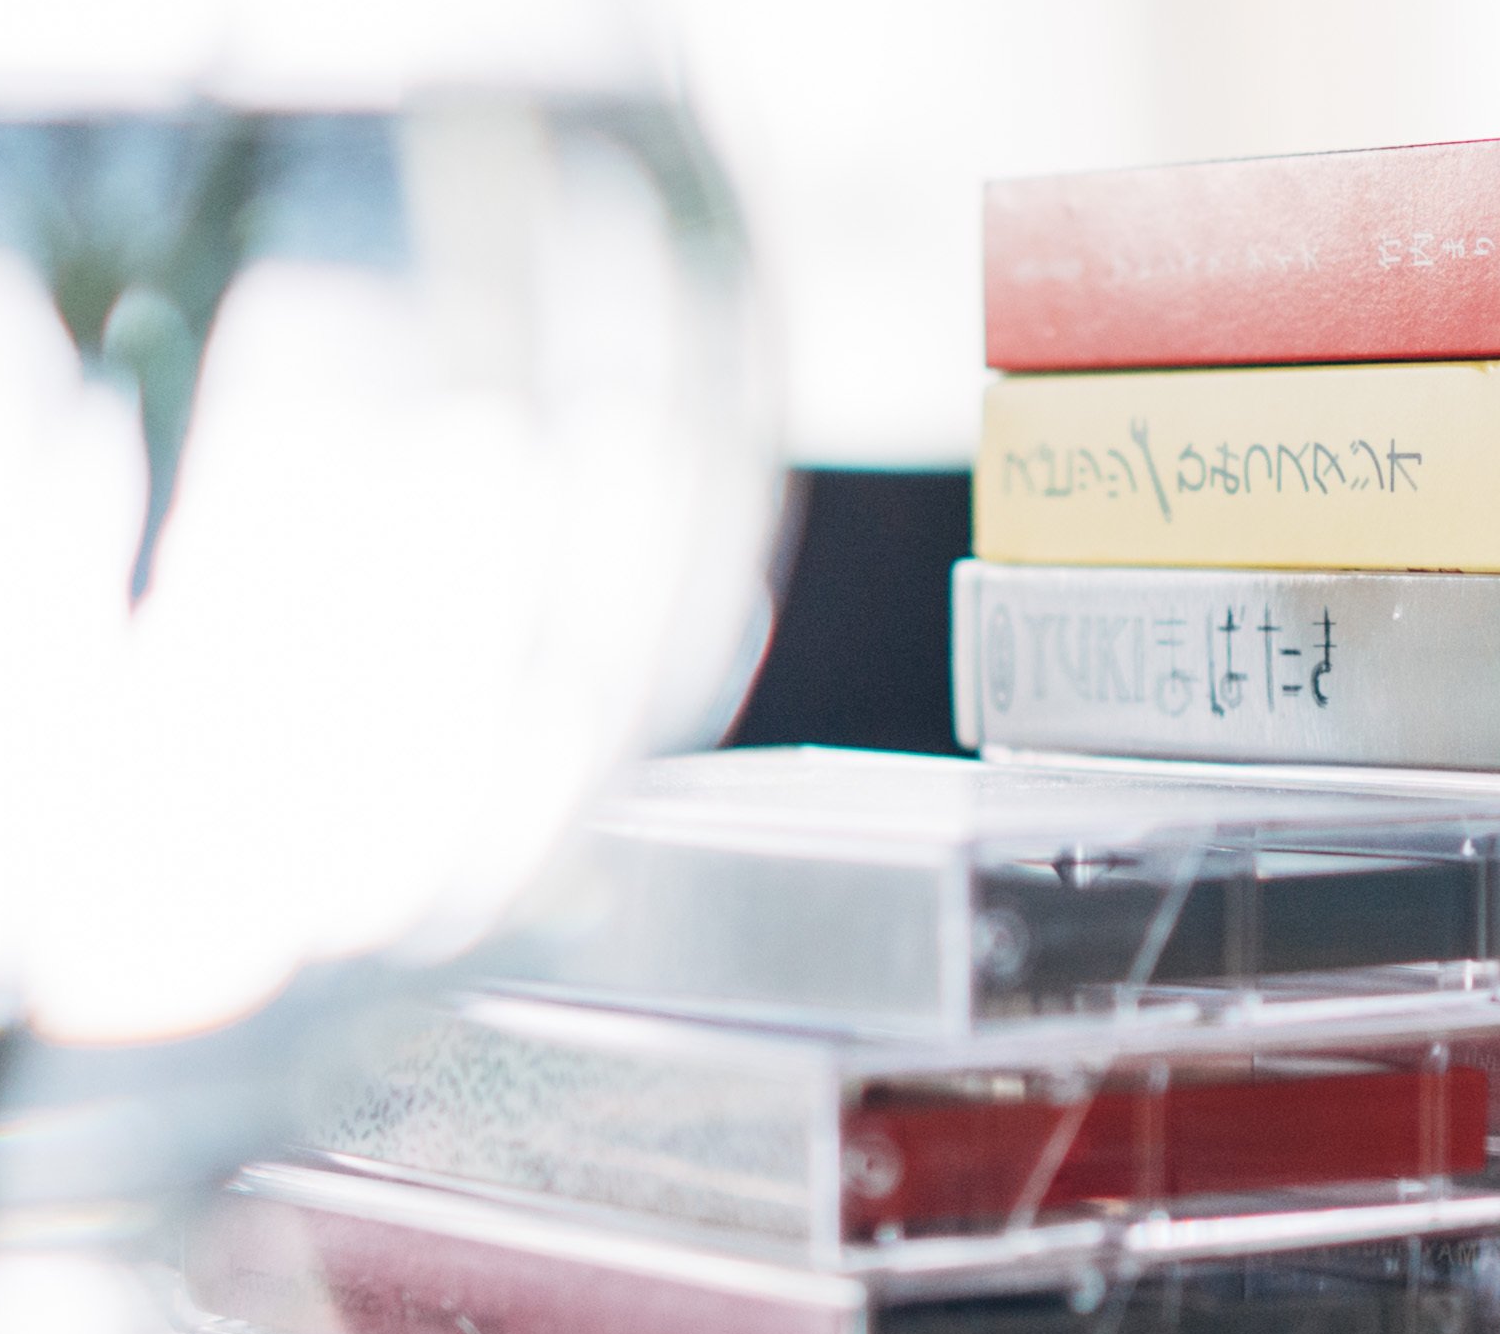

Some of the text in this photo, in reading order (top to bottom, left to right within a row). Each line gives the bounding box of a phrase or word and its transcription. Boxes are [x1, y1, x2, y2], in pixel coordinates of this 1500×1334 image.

[1174, 439, 1422, 497] ひみつスタジオ
[1022, 603, 1338, 718] YUKI まばたき
